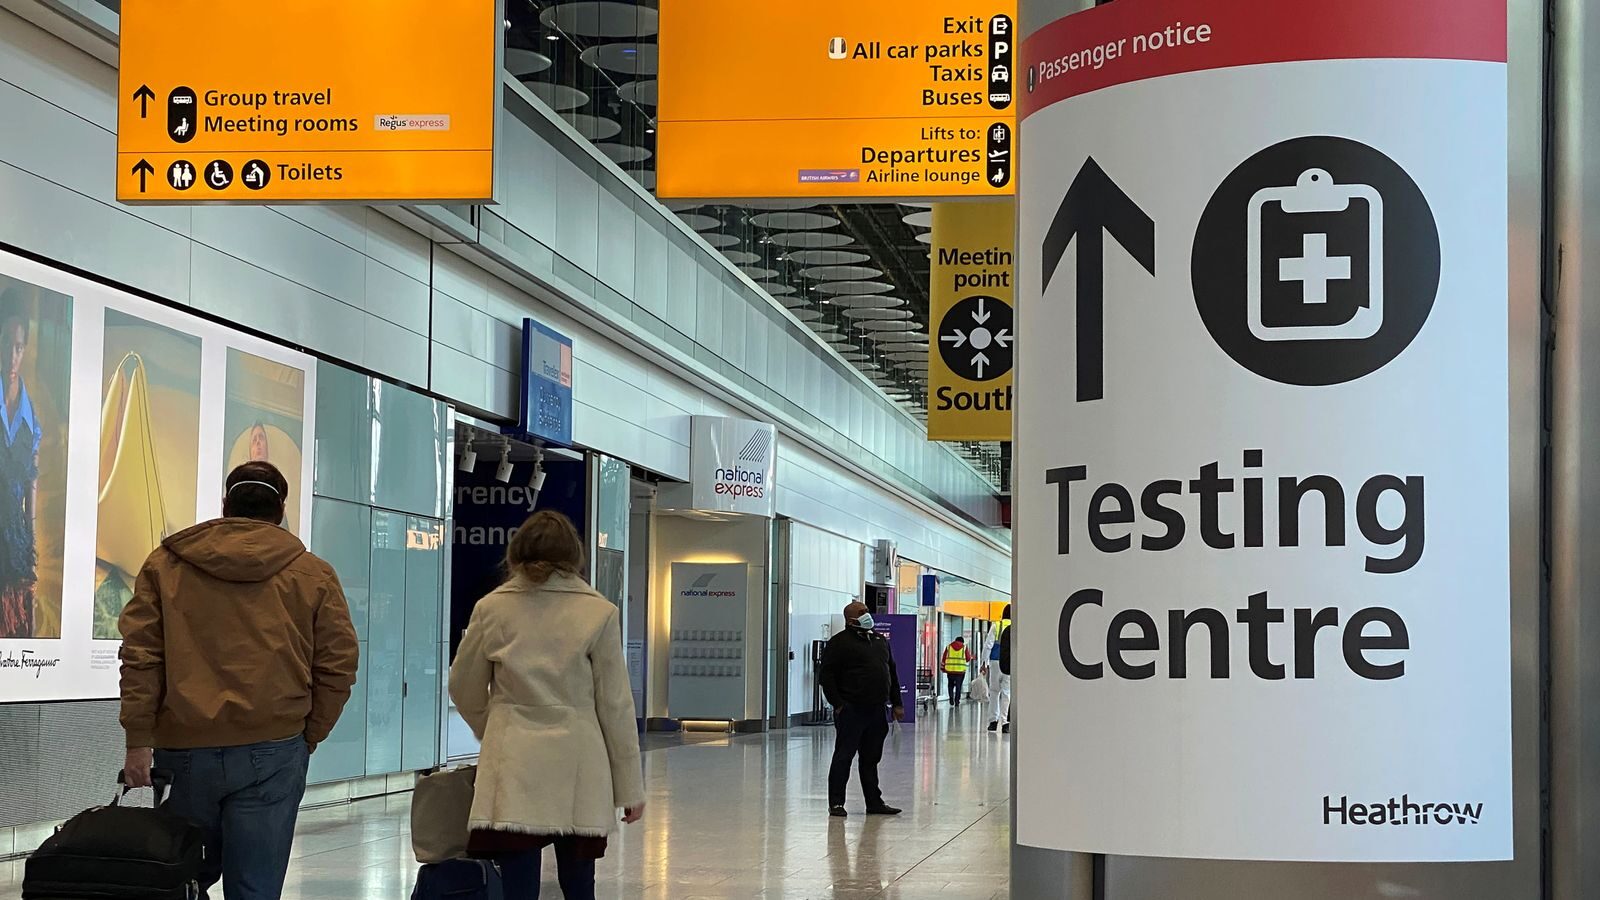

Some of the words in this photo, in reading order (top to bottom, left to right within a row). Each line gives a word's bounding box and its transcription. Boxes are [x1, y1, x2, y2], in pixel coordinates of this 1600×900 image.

[943, 15, 984, 34] Exit
[852, 41, 881, 60] All
[887, 45, 919, 59] car
[925, 39, 984, 62] parks
[1039, 38, 1127, 84] Passenger
[1132, 21, 1212, 54] notice
[929, 63, 983, 82] Taxis
[204, 89, 267, 110] Group
[273, 87, 332, 105] travel
[922, 89, 983, 106] Buses
[204, 114, 288, 136] Meeting
[294, 117, 359, 132] rooms
[379, 116, 407, 130] Regus
[408, 119, 445, 129] express
[921, 126, 955, 140] Lifts
[959, 128, 981, 140] to:
[861, 146, 981, 168] Departures
[276, 163, 343, 181] Toilets
[866, 168, 920, 183] Airline
[924, 168, 981, 185] lounge
[938, 247, 1015, 266] Meetin
[954, 269, 1010, 292] point
[715, 465, 764, 485] national
[453, 486, 540, 512] rency
[714, 482, 764, 500] express
[1045, 448, 1426, 575] Testing
[680, 589, 708, 597] national
[709, 590, 736, 598] express
[1057, 588, 1411, 681] Centre
[1322, 793, 1484, 826] Heathrow
